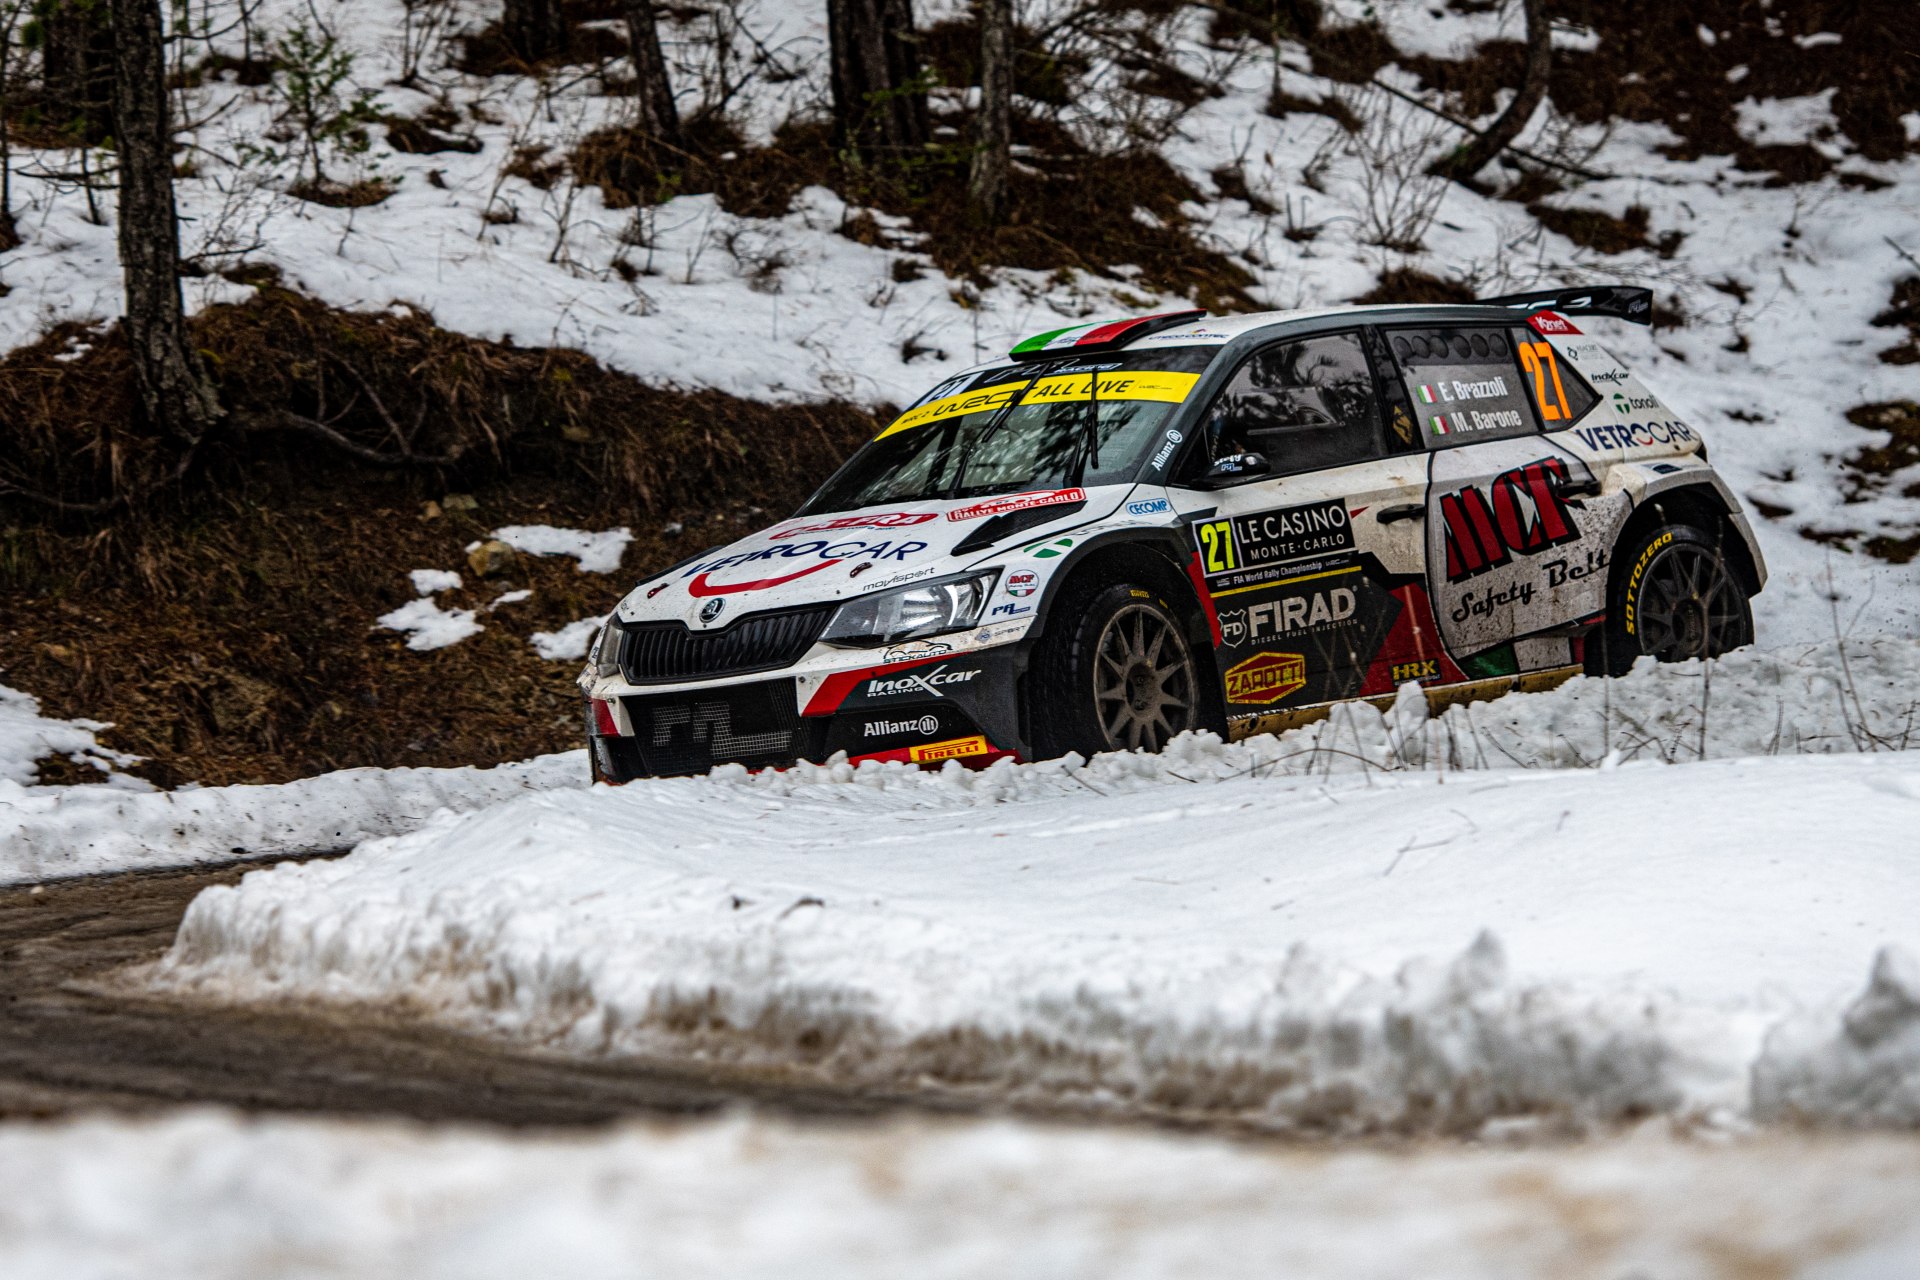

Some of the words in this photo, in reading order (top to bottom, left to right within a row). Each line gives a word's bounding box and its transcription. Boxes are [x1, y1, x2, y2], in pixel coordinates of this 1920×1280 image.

[1033, 383, 1075, 398] ALL
[1080, 380, 1135, 394] LIVE
[1438, 382, 1454, 401] E.
[1452, 376, 1509, 400] Brazzoli
[1518, 341, 1572, 421] 27
[1629, 394, 1659, 410] tonoli
[1451, 412, 1473, 432] M.
[1470, 409, 1523, 430] Barone
[1576, 421, 1698, 452] VETROCAR
[1151, 441, 1176, 472] Allianz
[954, 507, 994, 520] RALLYE
[1128, 500, 1169, 515] CECOMP
[1439, 456, 1587, 585] MCF
[1200, 521, 1235, 573] 27
[1238, 520, 1261, 544] LE
[1263, 505, 1346, 539] CASINO
[681, 541, 928, 578] VETROCAR
[862, 567, 936, 592] movisport
[1233, 575, 1245, 585] FIA
[1245, 571, 1263, 583] World
[1264, 568, 1280, 579] Rally
[1280, 561, 1322, 576] Championship
[1626, 532, 1673, 636] SOTTOZERO
[1248, 587, 1357, 638] FIRAD
[1452, 581, 1537, 622] Safety
[1222, 620, 1243, 638] FD
[1251, 634, 1282, 646] DIESEL
[1286, 629, 1307, 638] FUEL
[1312, 619, 1358, 632] INJECTION
[1227, 660, 1304, 696] ZAROTTI
[1392, 660, 1437, 680] HRX
[867, 686, 925, 697] RACING
[864, 719, 919, 737] Allianz
[918, 740, 980, 761] PIRELLI
